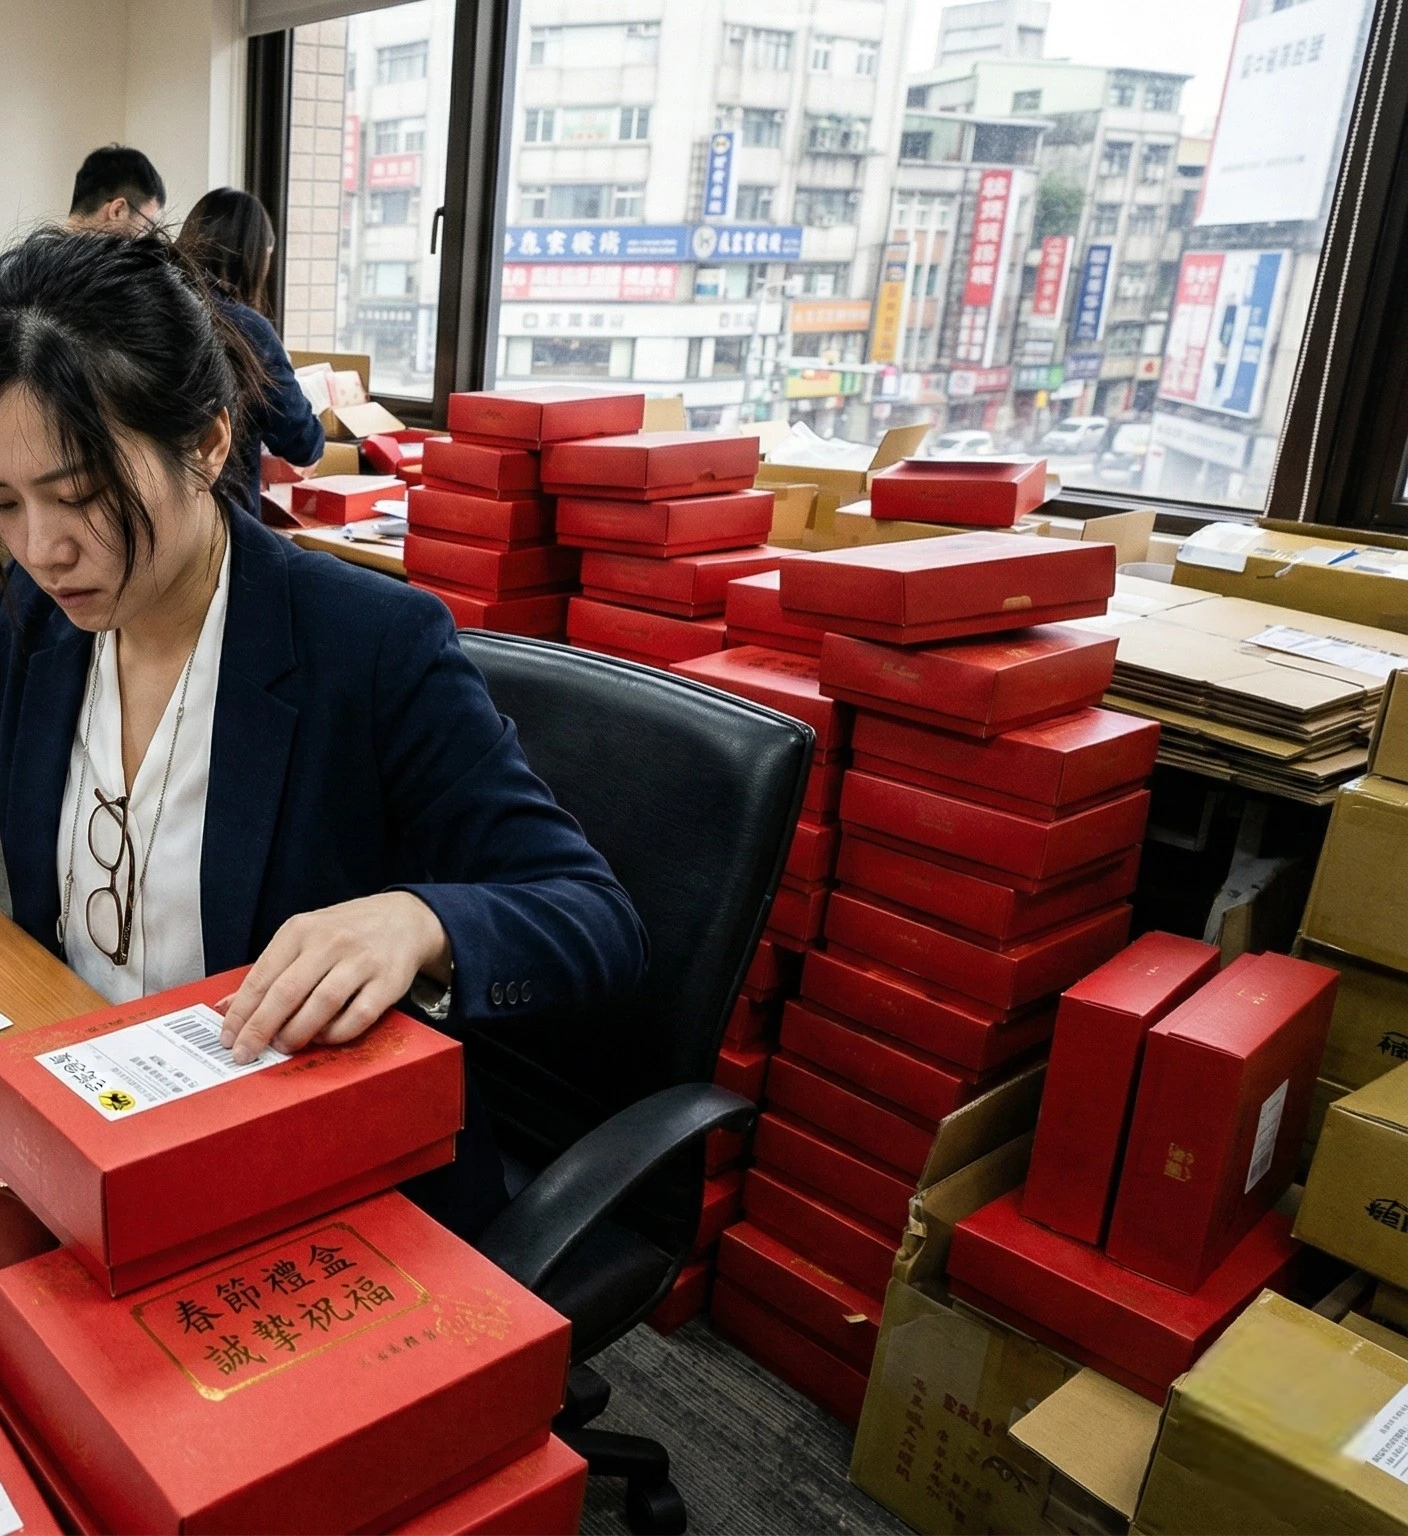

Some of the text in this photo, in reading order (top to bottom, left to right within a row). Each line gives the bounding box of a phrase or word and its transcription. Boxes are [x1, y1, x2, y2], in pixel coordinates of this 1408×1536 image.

[174, 1243, 358, 1335] 春節禮盒
[203, 1276, 396, 1376] 誠摯祝福
